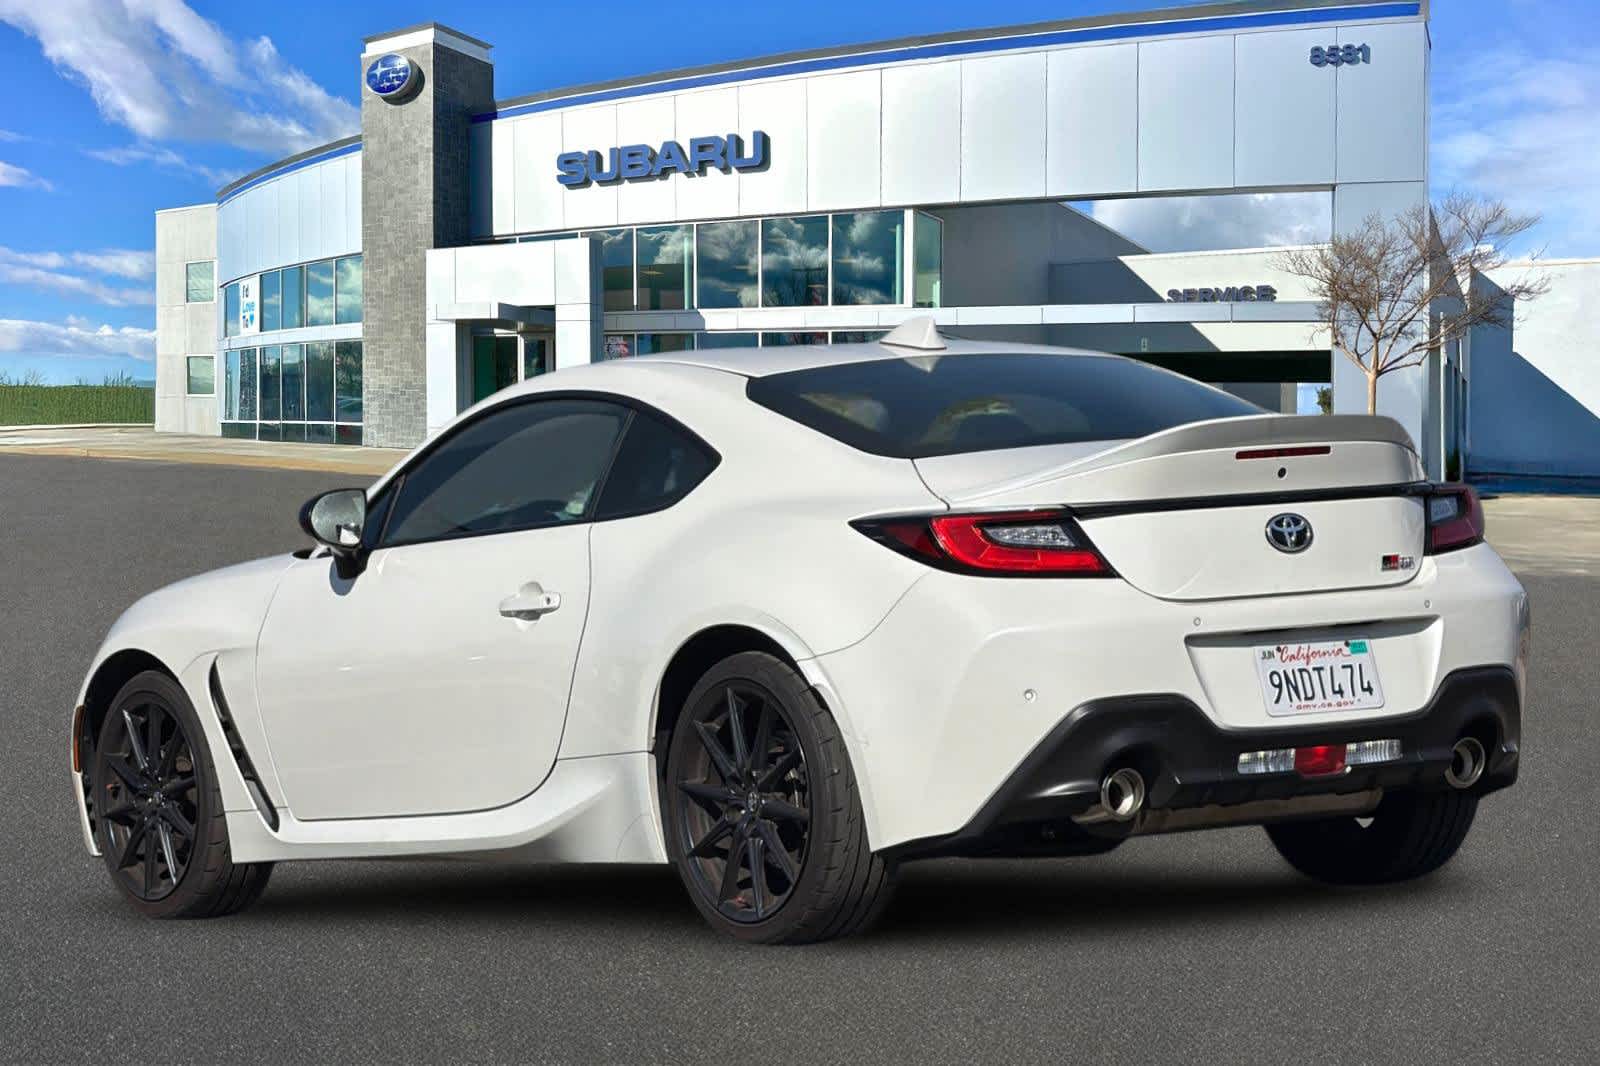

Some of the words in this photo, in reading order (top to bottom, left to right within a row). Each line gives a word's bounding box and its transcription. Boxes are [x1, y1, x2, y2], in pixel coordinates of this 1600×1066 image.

[556, 130, 768, 188] SUBARU
[1166, 285, 1277, 303] SERVICE
[1280, 645, 1350, 666] California
[1268, 663, 1374, 705] 9NDT474
